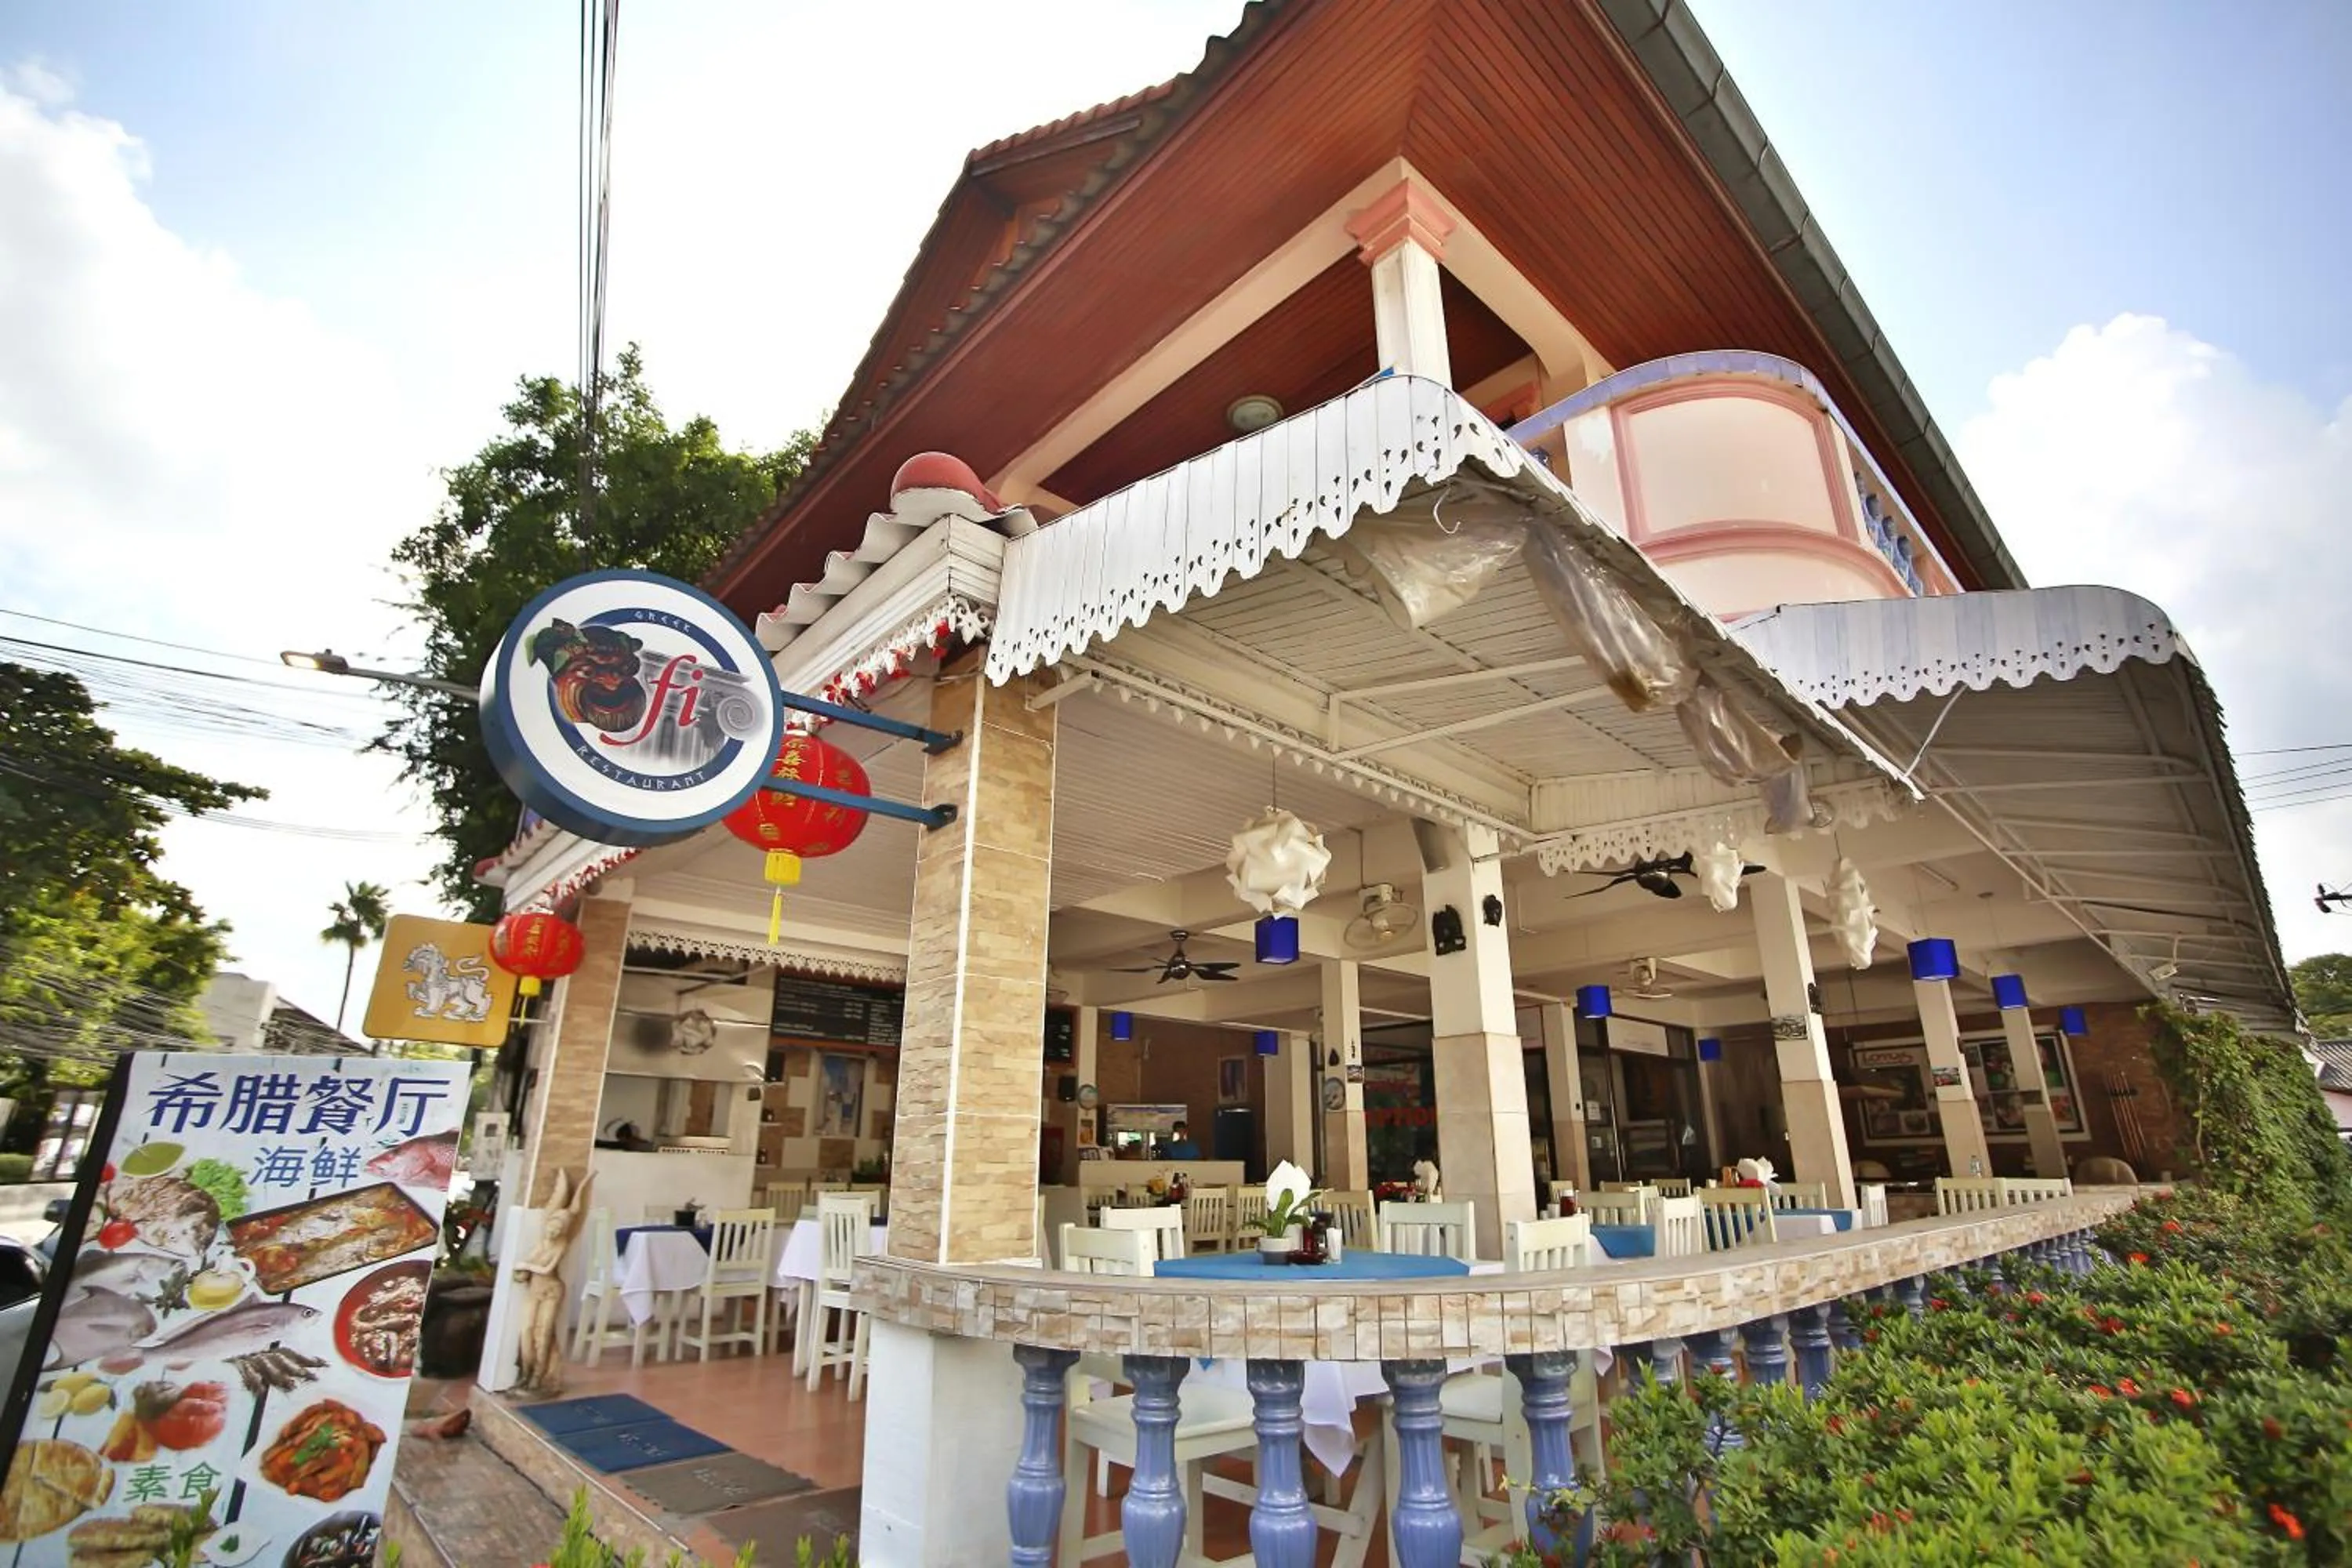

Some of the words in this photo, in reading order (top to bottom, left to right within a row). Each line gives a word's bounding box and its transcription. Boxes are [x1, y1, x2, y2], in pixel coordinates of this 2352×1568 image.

[633, 611, 691, 633] GREEK
[576, 745, 704, 790] RESTAURANT
[147, 1072, 451, 1137] 希腊餐厅
[249, 1145, 363, 1189] 海鲜
[123, 1461, 222, 1502] 素食
